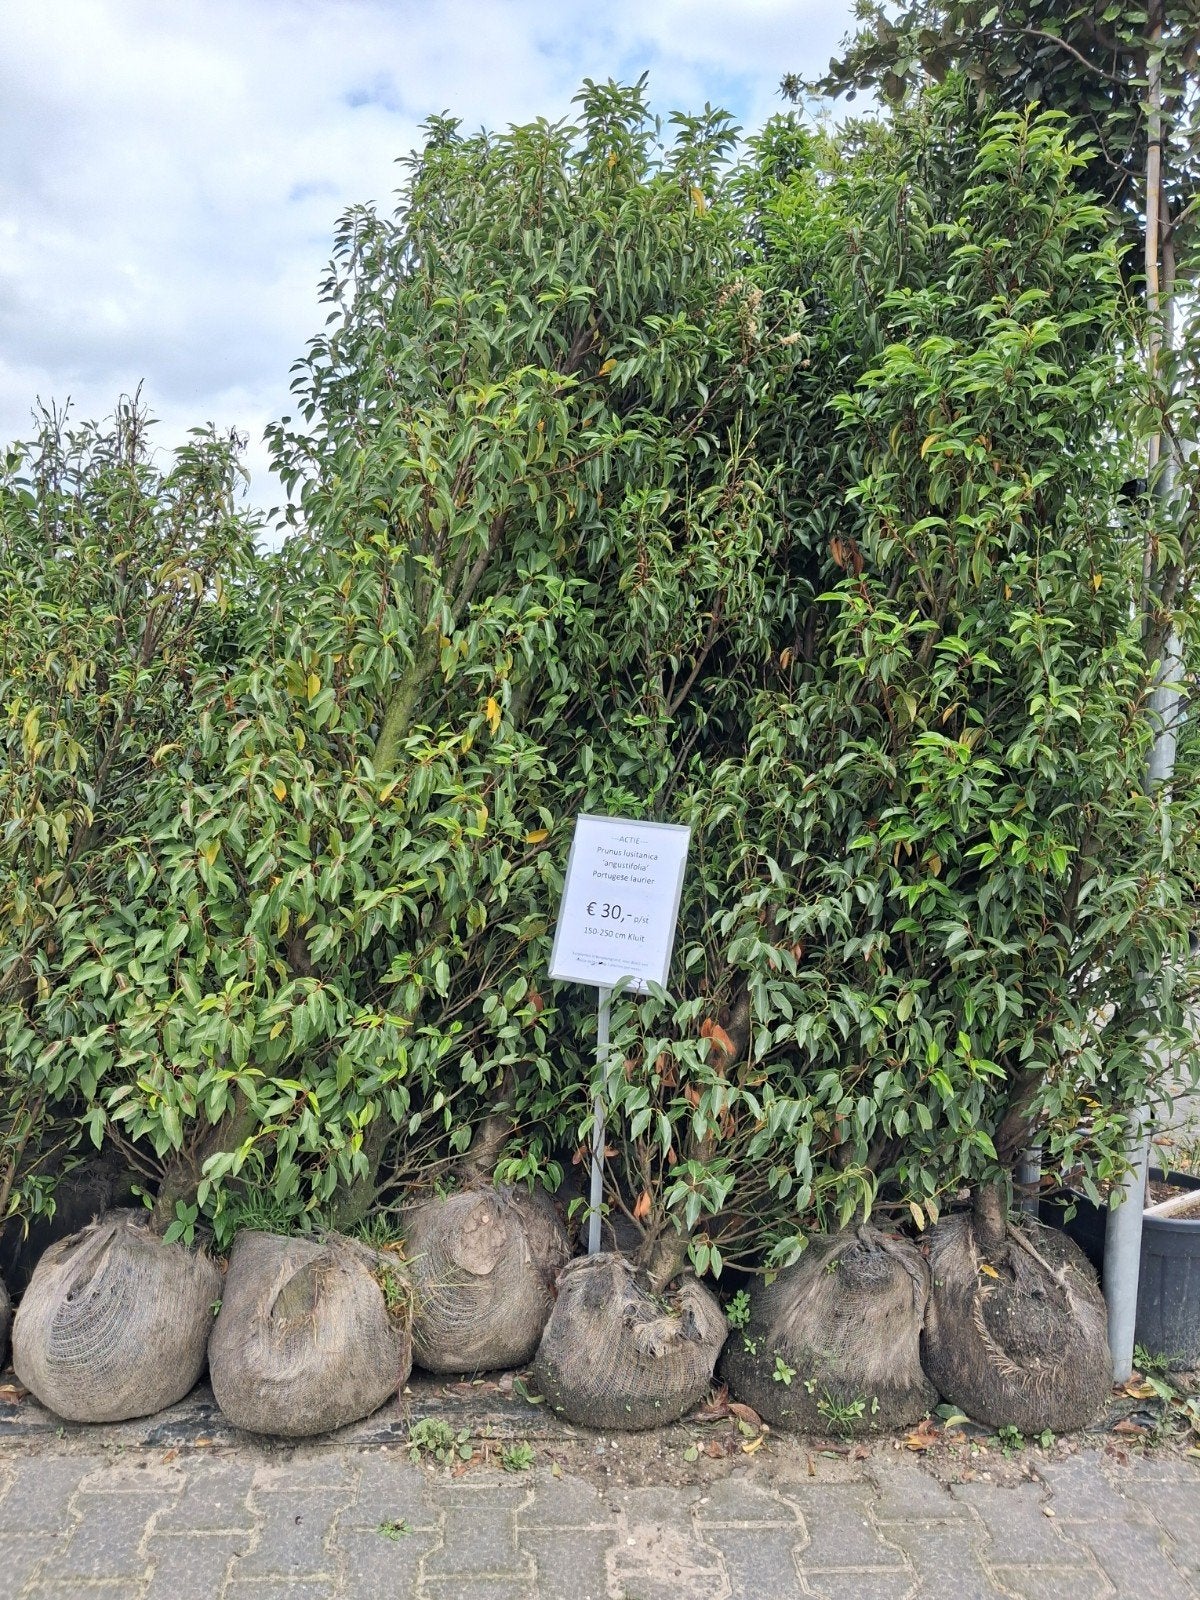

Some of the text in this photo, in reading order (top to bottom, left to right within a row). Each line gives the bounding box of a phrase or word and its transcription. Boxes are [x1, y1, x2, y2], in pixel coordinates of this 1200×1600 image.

[597, 846, 658, 861] Prunus lusitanica
[592, 870, 655, 885] Portugese laurier
[586, 901, 597, 916] €
[584, 926, 613, 938] 150-250
[627, 931, 645, 942] Kluit
